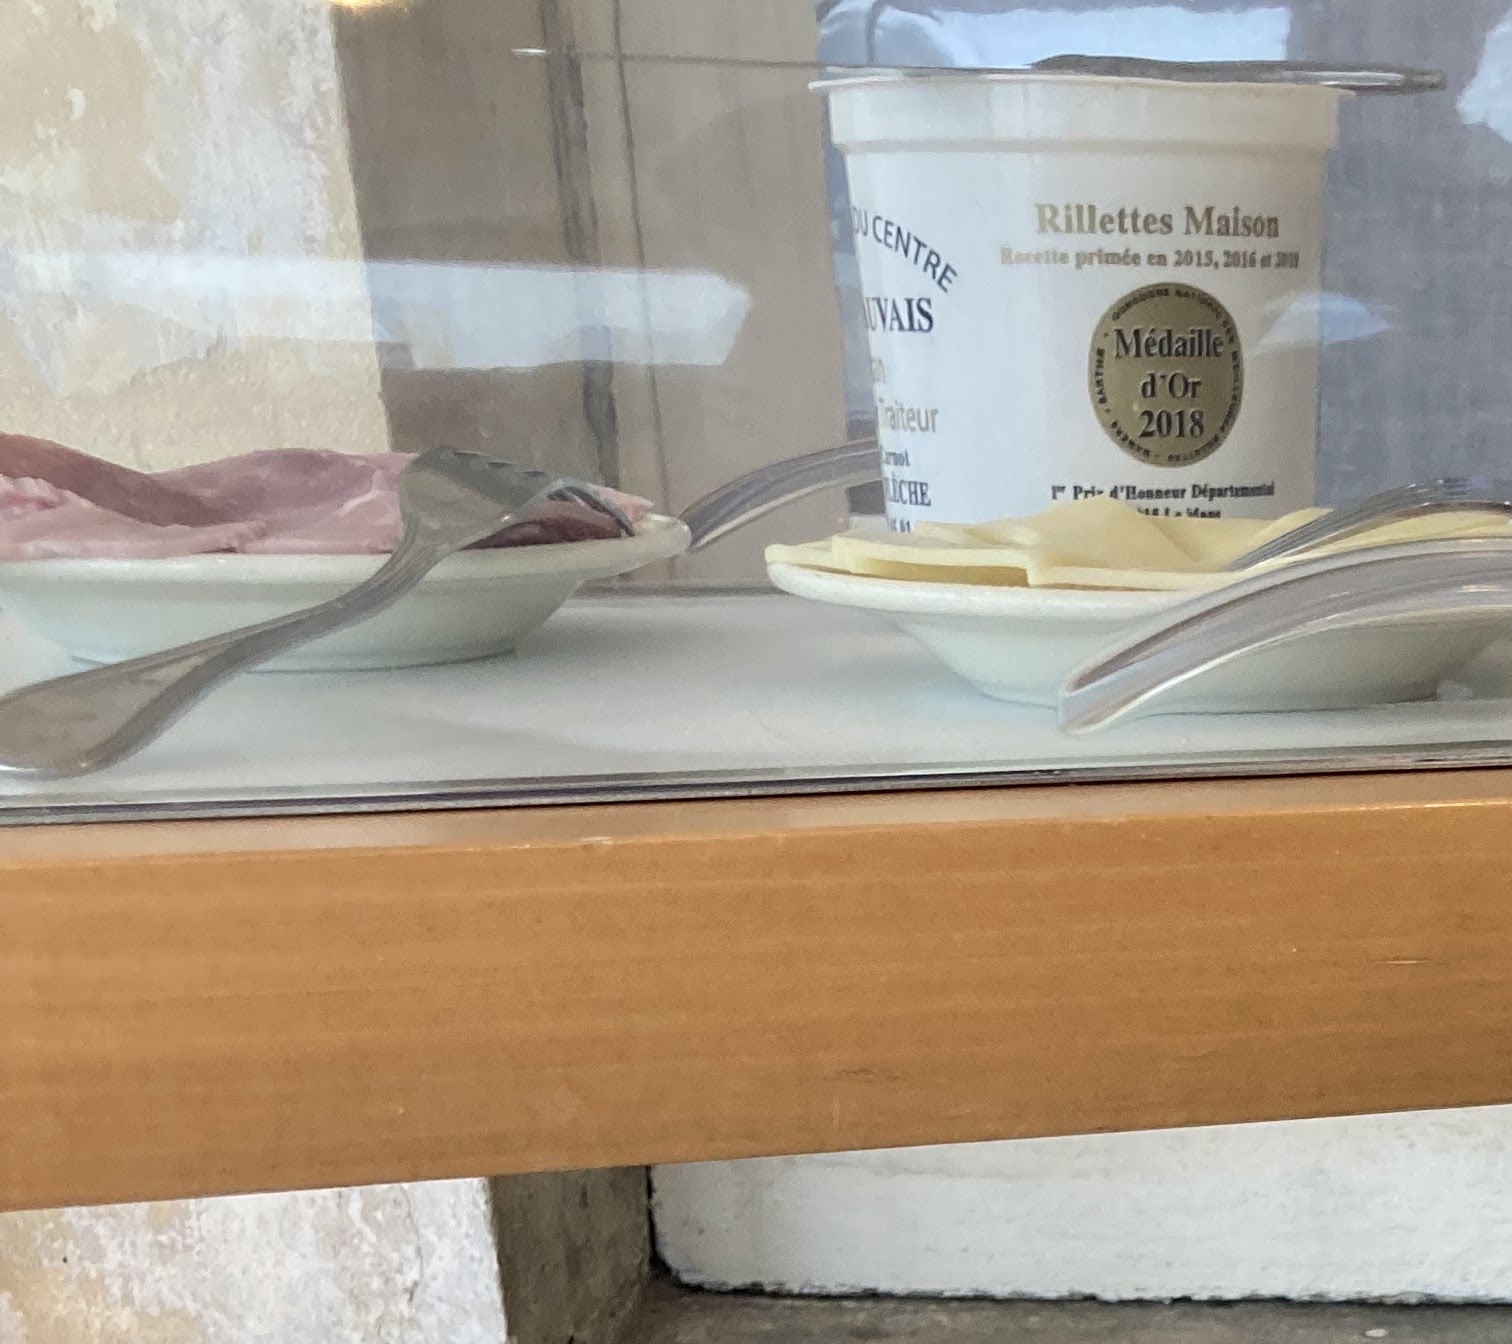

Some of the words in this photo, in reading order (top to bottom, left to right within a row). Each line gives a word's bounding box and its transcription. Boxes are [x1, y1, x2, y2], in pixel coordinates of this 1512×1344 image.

[1034, 203, 1173, 235] Rillettes
[1184, 205, 1280, 238] Maison
[872, 215, 958, 293] CENTRE
[1075, 248, 1141, 270] primée
[1147, 252, 1168, 268] en
[1113, 327, 1225, 360] Médaille
[1140, 371, 1203, 400] d'Or
[1139, 409, 1205, 439] 2018
